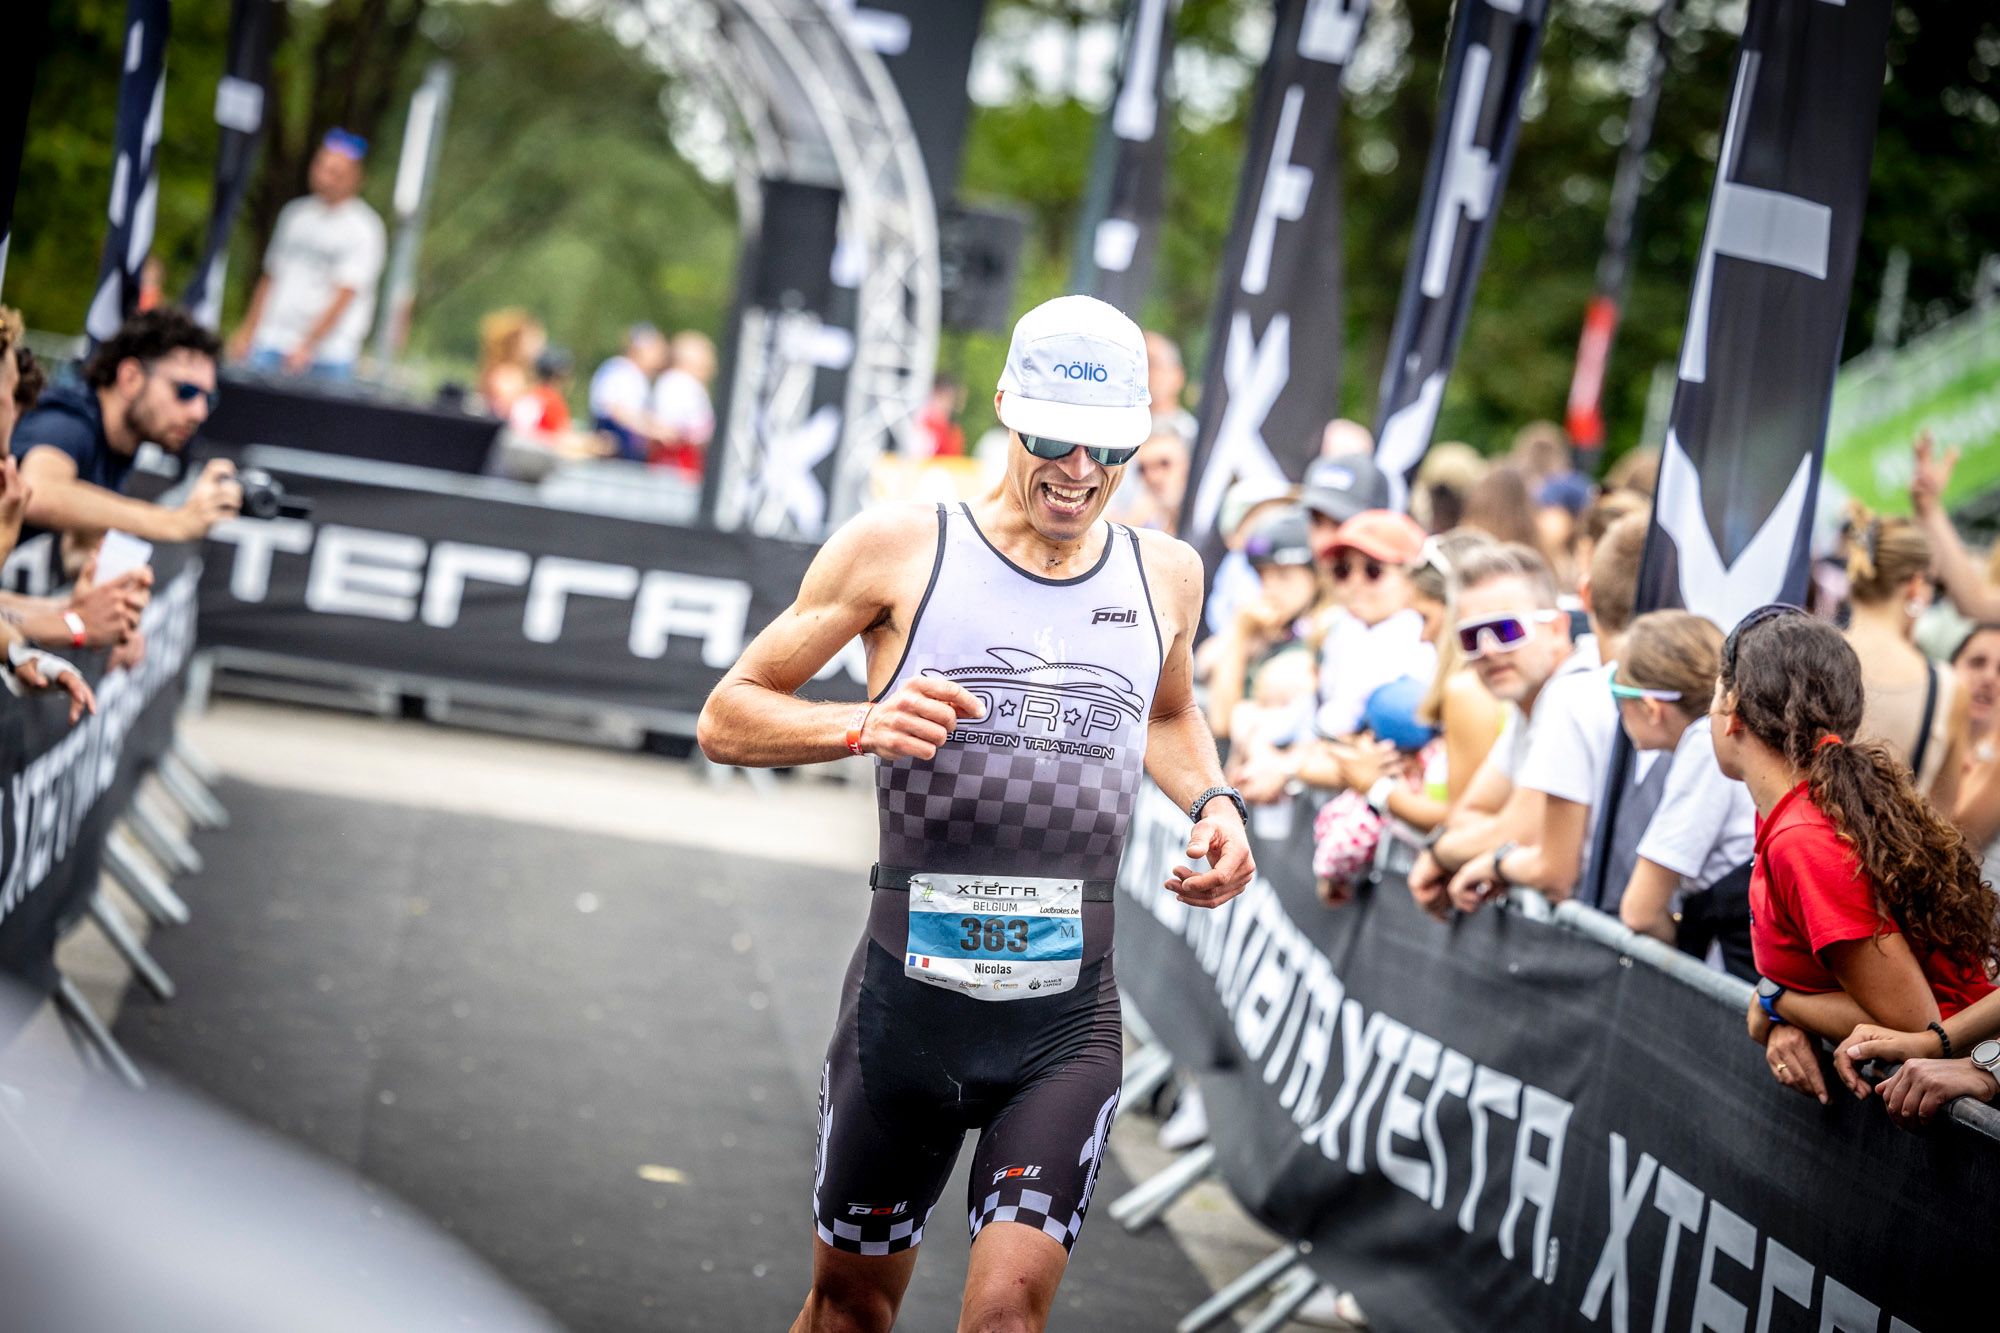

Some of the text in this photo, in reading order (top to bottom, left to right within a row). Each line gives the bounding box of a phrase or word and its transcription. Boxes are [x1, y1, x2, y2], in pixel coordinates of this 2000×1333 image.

[1053, 361, 1108, 383] nöliö
[1091, 608, 1138, 626] poli
[1023, 737, 1115, 760] TRIATHLON
[972, 901, 1018, 913] BELGIUM
[1040, 906, 1080, 915] Ladbrokes.be
[960, 917, 1029, 953] 363
[1060, 925, 1076, 939] M
[974, 963, 1012, 975] Nicolas
[1301, 998, 1575, 1280] XTERRA
[992, 1165, 1042, 1186] poli
[848, 1201, 908, 1216] poli
